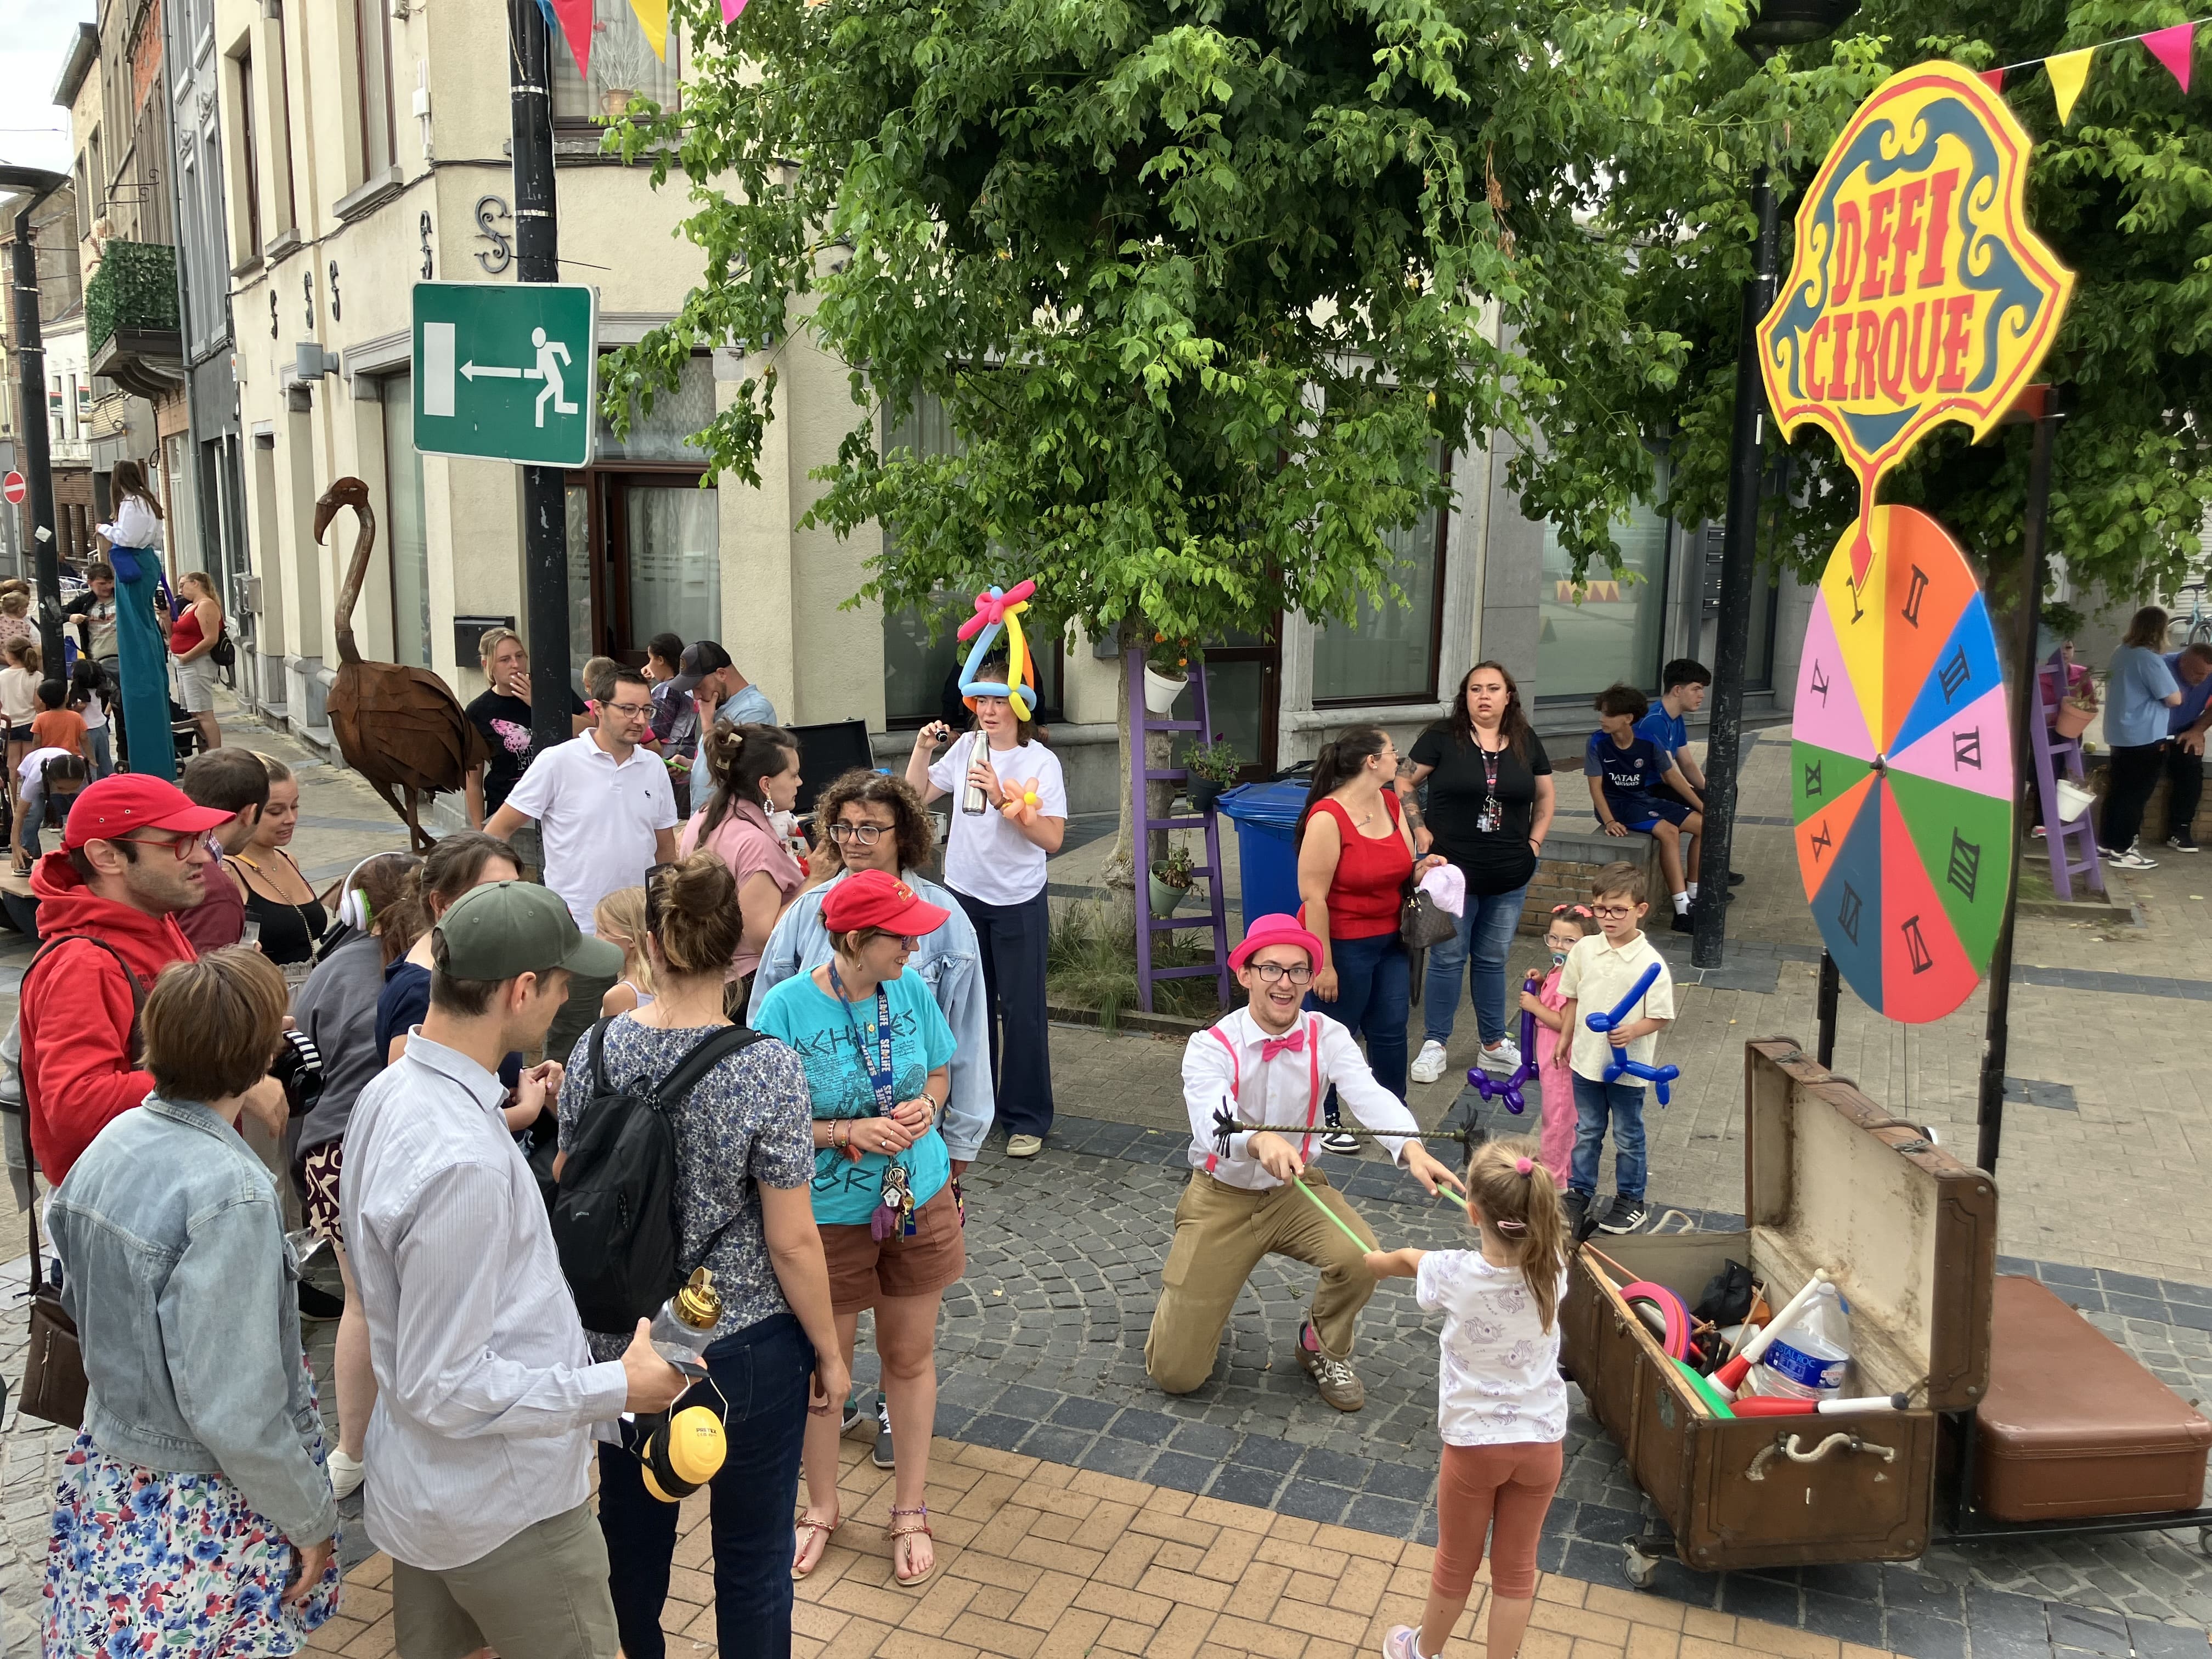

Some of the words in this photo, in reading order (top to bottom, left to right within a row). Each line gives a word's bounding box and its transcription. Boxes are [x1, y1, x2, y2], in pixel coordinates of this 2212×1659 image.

[1831, 167, 1960, 308] DEFI
[1805, 294, 1975, 407] CIRQUE
[1902, 564, 1929, 629] II
[1810, 659, 1829, 709] V
[1938, 644, 1971, 704] III
[1811, 820, 1831, 863] X
